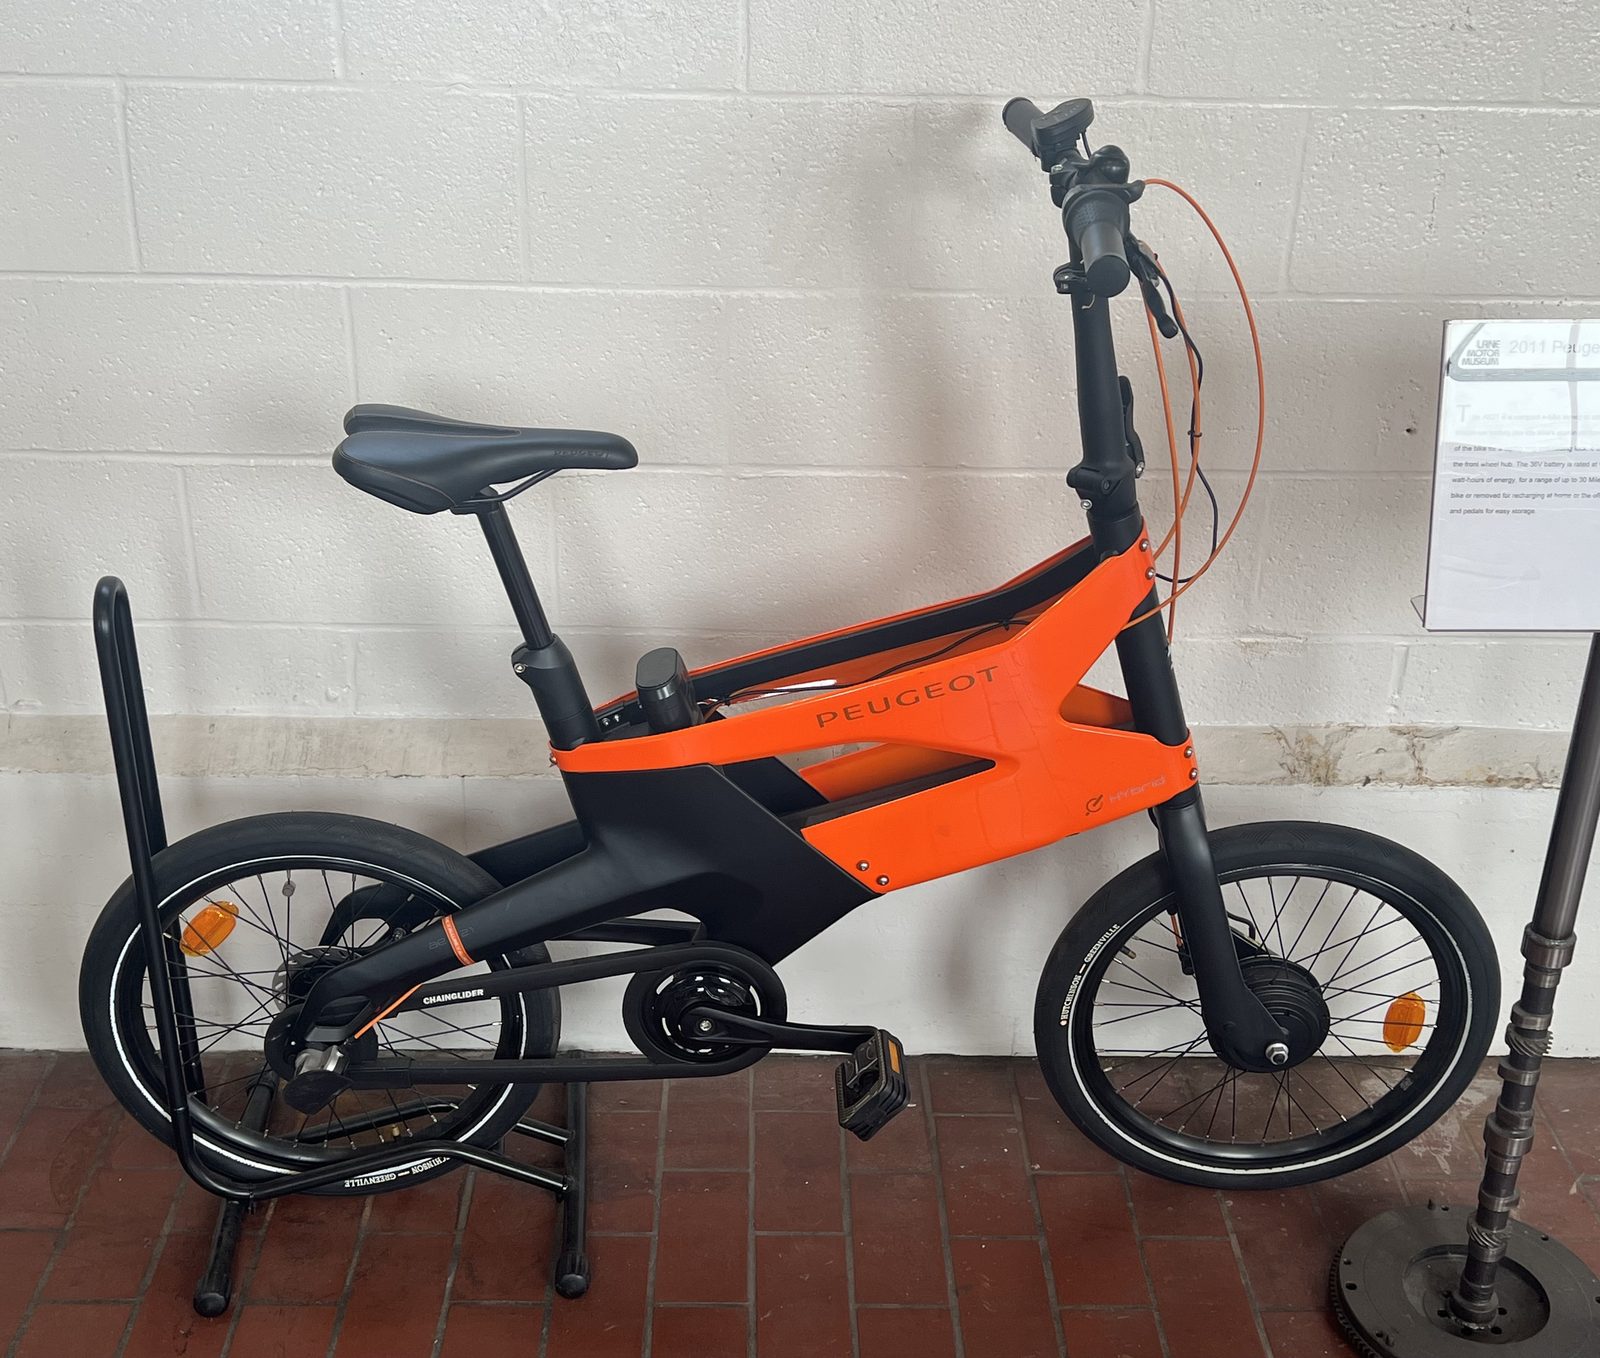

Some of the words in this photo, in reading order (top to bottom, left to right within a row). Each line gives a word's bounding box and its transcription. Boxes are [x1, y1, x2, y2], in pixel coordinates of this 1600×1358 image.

[1466, 349, 1500, 357] MOTOR
[1509, 340, 1546, 353] 2011
[1461, 358, 1499, 366] MUSEUM
[1517, 460, 1528, 468] The
[1543, 461, 1566, 470] battery
[1512, 492, 1545, 500] recharging
[816, 666, 998, 728] PEUGEOT
[1060, 974, 1082, 1020] HUTCHINSON
[1084, 924, 1120, 963] GREENVILLE
[423, 989, 484, 1005] CHAINGLIDER
[411, 1156, 450, 1175] CHINSON
[344, 1172, 397, 1188] GREENVILLE
